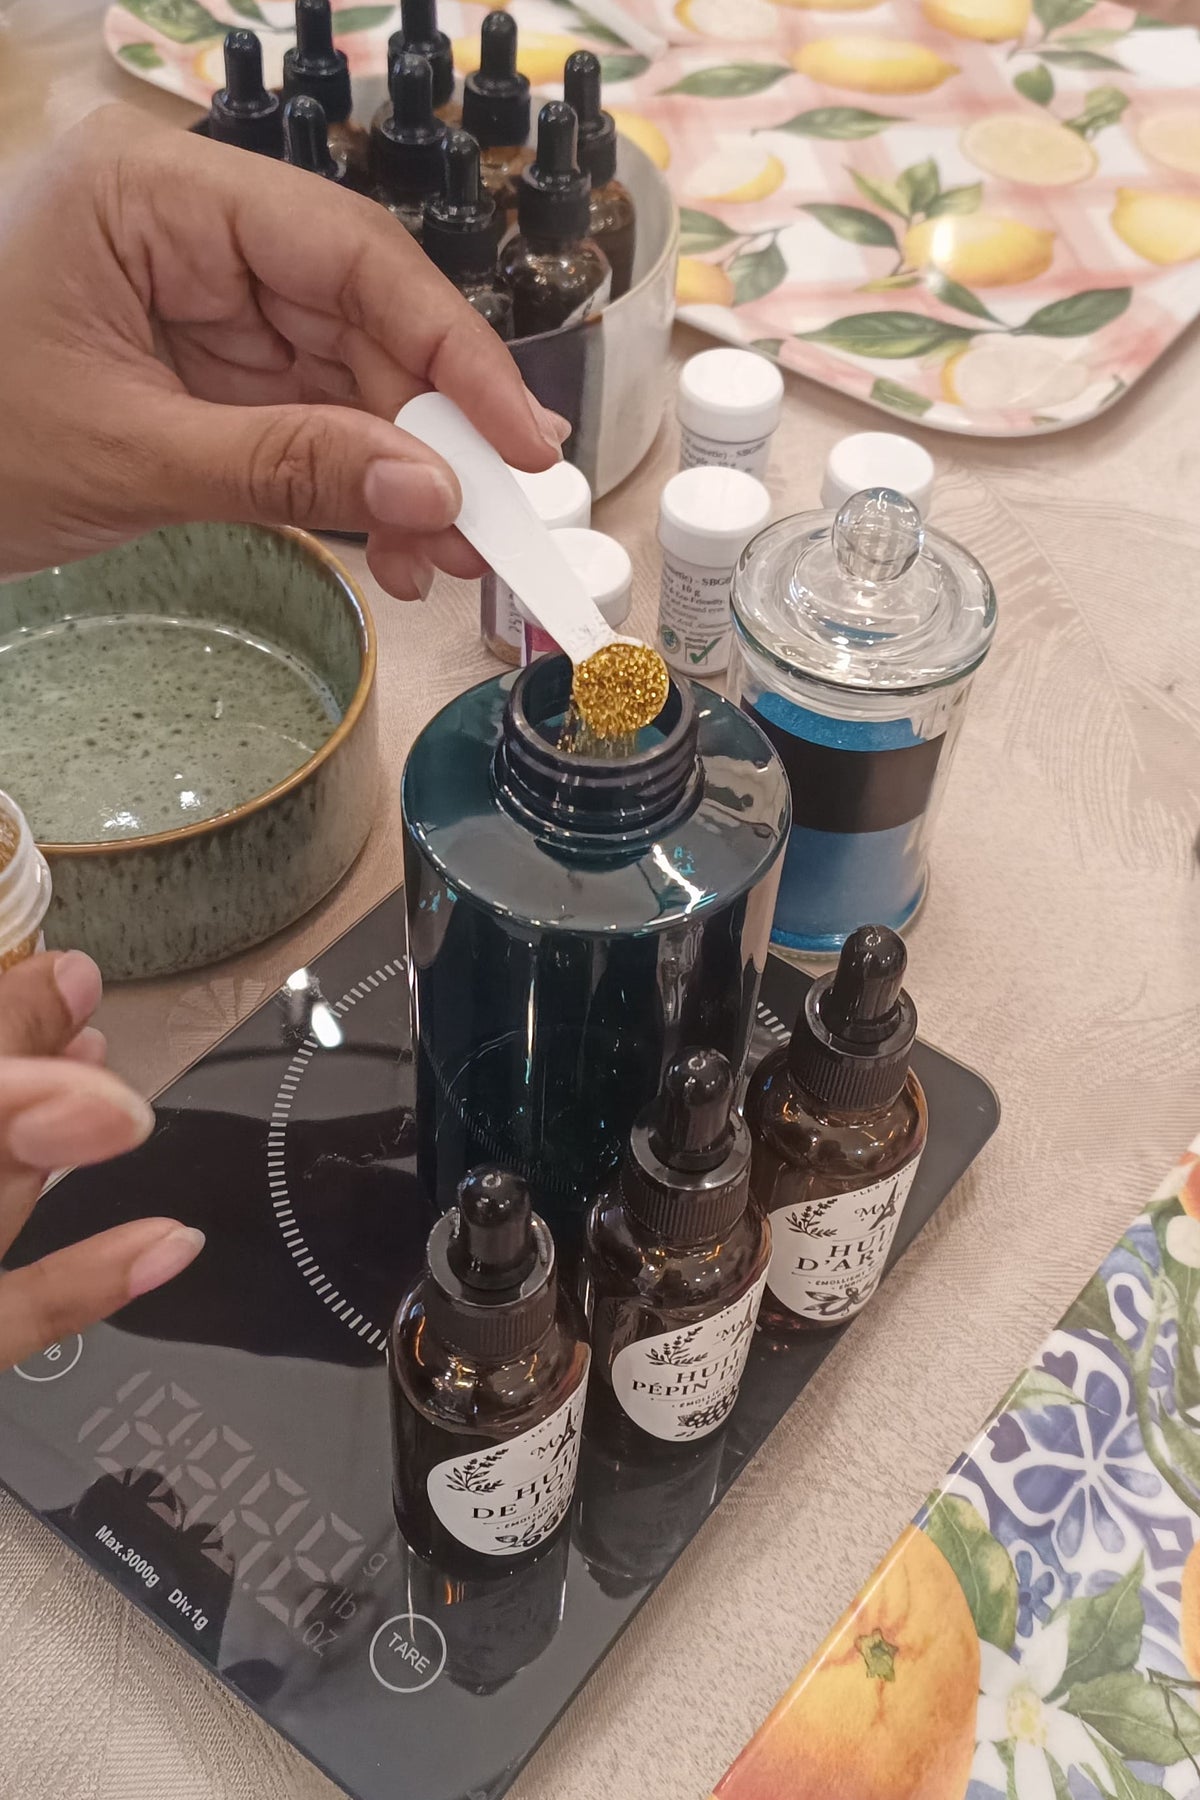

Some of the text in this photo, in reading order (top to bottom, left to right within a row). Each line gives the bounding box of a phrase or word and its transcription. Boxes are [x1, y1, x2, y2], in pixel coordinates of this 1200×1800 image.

[632, 1378, 710, 1396] PÉPIN
[472, 1503, 518, 1519] DE
[95, 1525, 209, 1631] Max.3000g Div.1g
[388, 1631, 430, 1674] TARE
